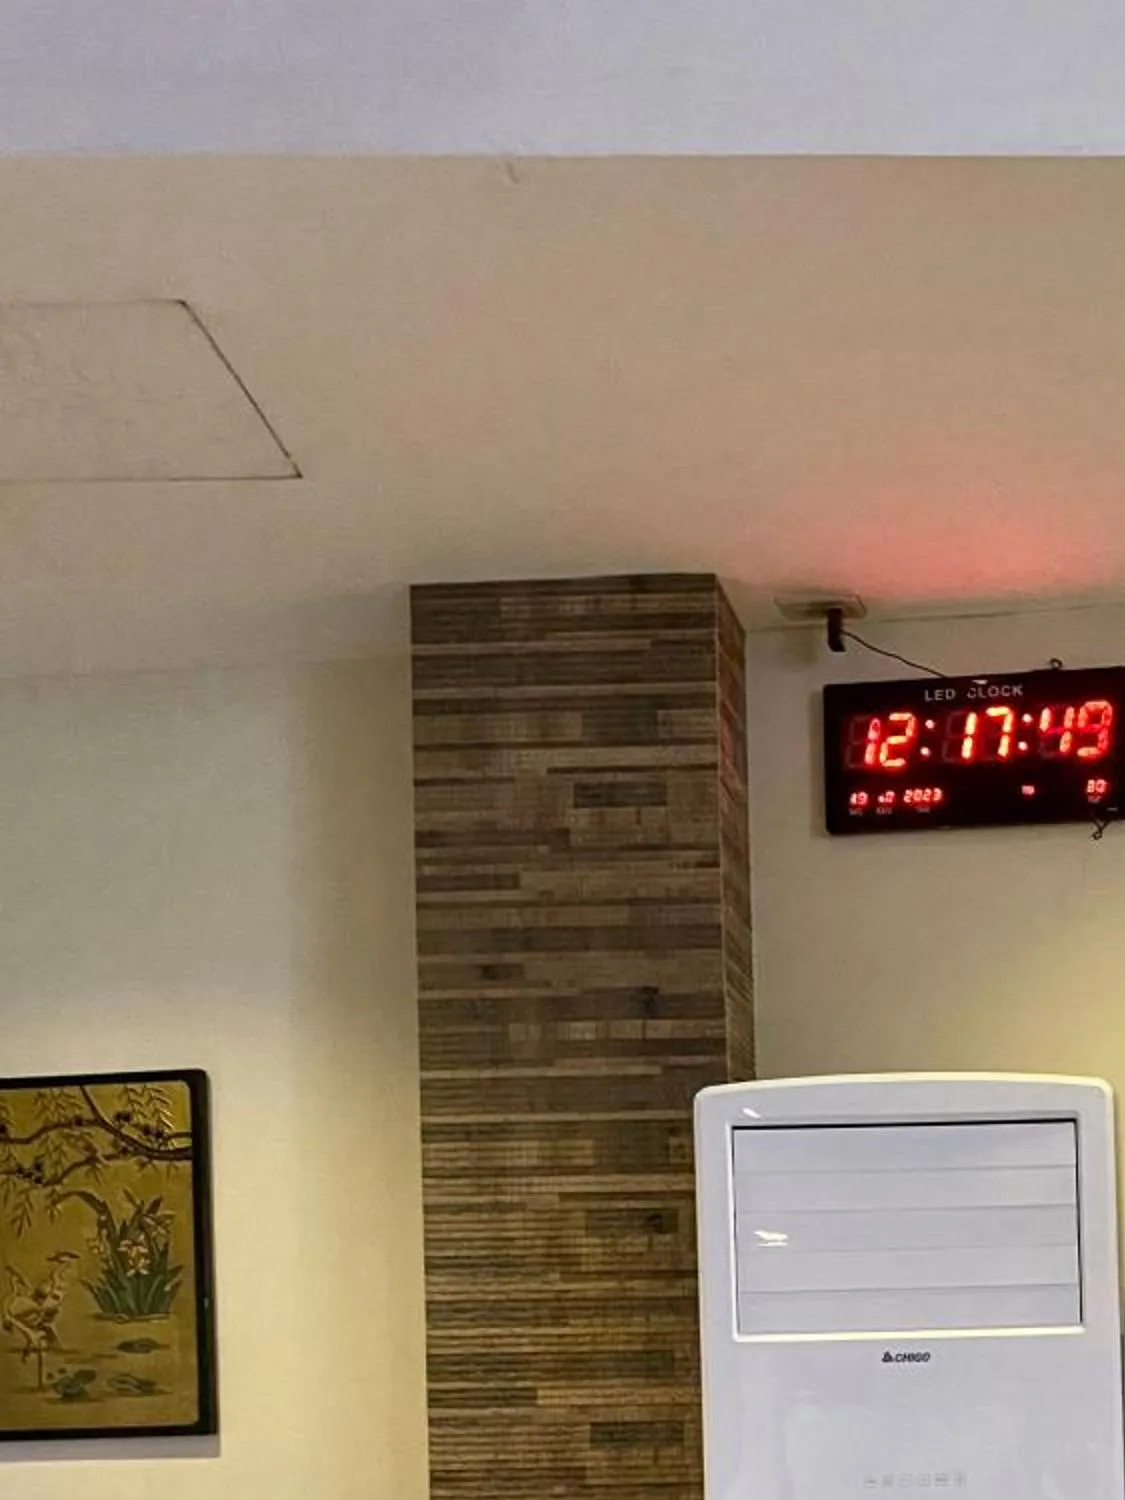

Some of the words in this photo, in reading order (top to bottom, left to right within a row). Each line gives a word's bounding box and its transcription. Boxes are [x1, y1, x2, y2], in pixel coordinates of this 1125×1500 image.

[924, 688, 957, 702] LED
[966, 684, 1024, 699] CLOCK
[864, 700, 1113, 768] 12:17:49
